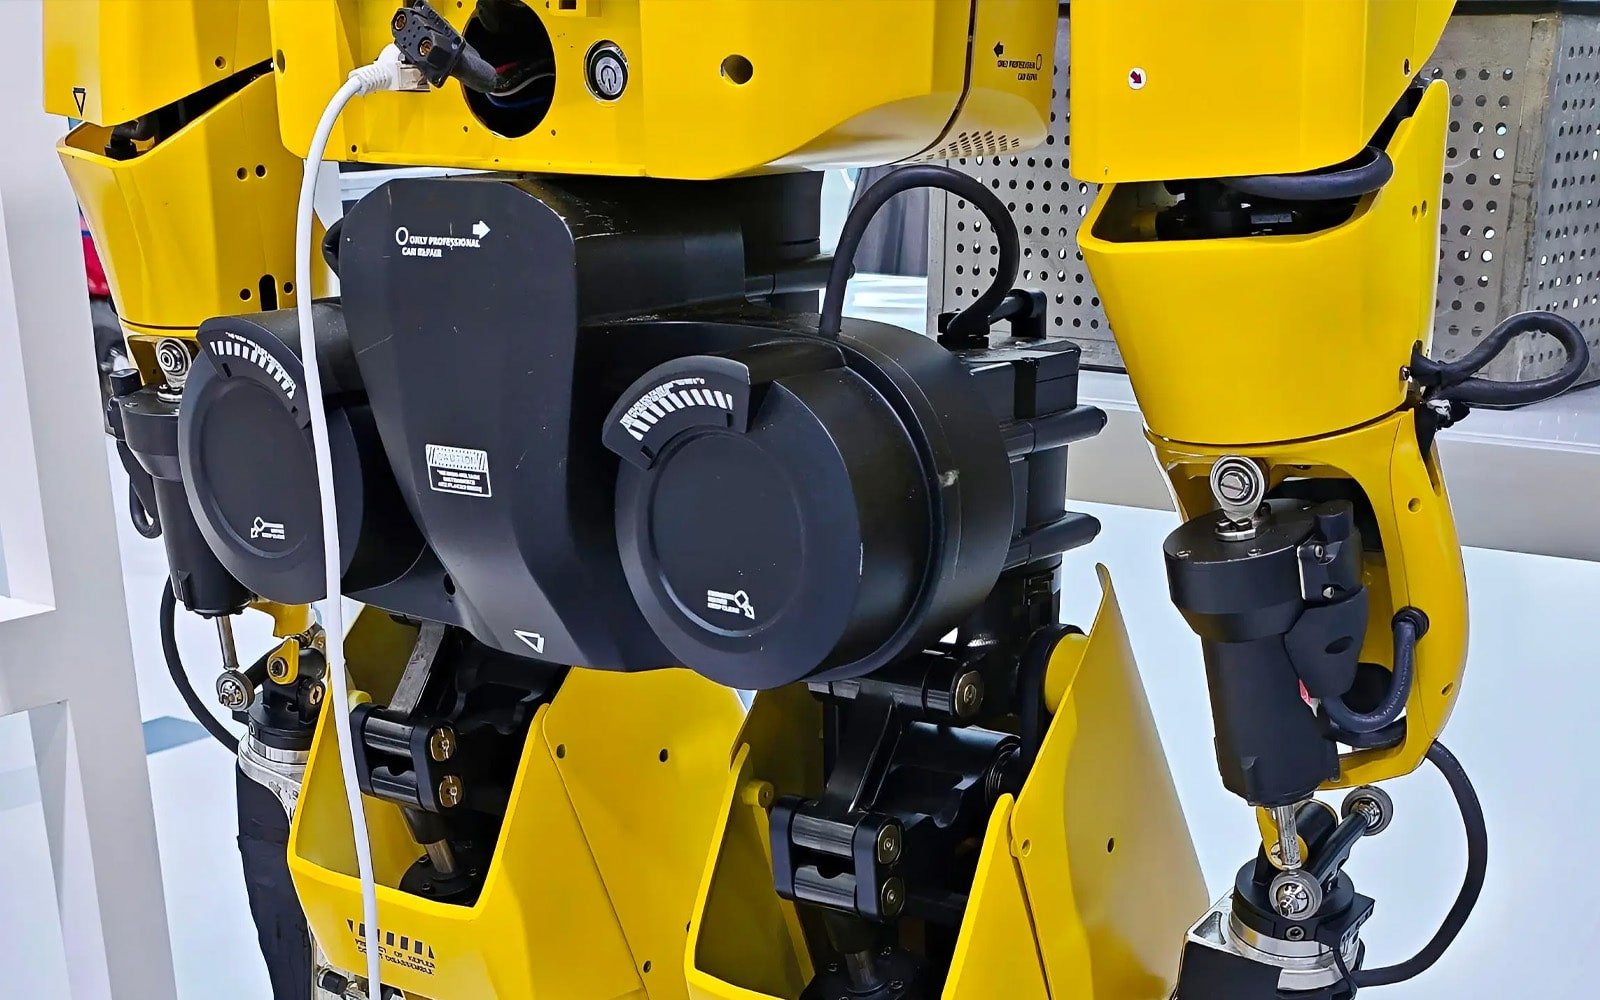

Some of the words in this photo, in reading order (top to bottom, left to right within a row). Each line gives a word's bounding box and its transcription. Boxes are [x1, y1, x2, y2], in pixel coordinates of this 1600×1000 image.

[409, 235, 428, 245] ONLY
[428, 236, 481, 248] PROFESSIONAL
[401, 246, 416, 256] CAN
